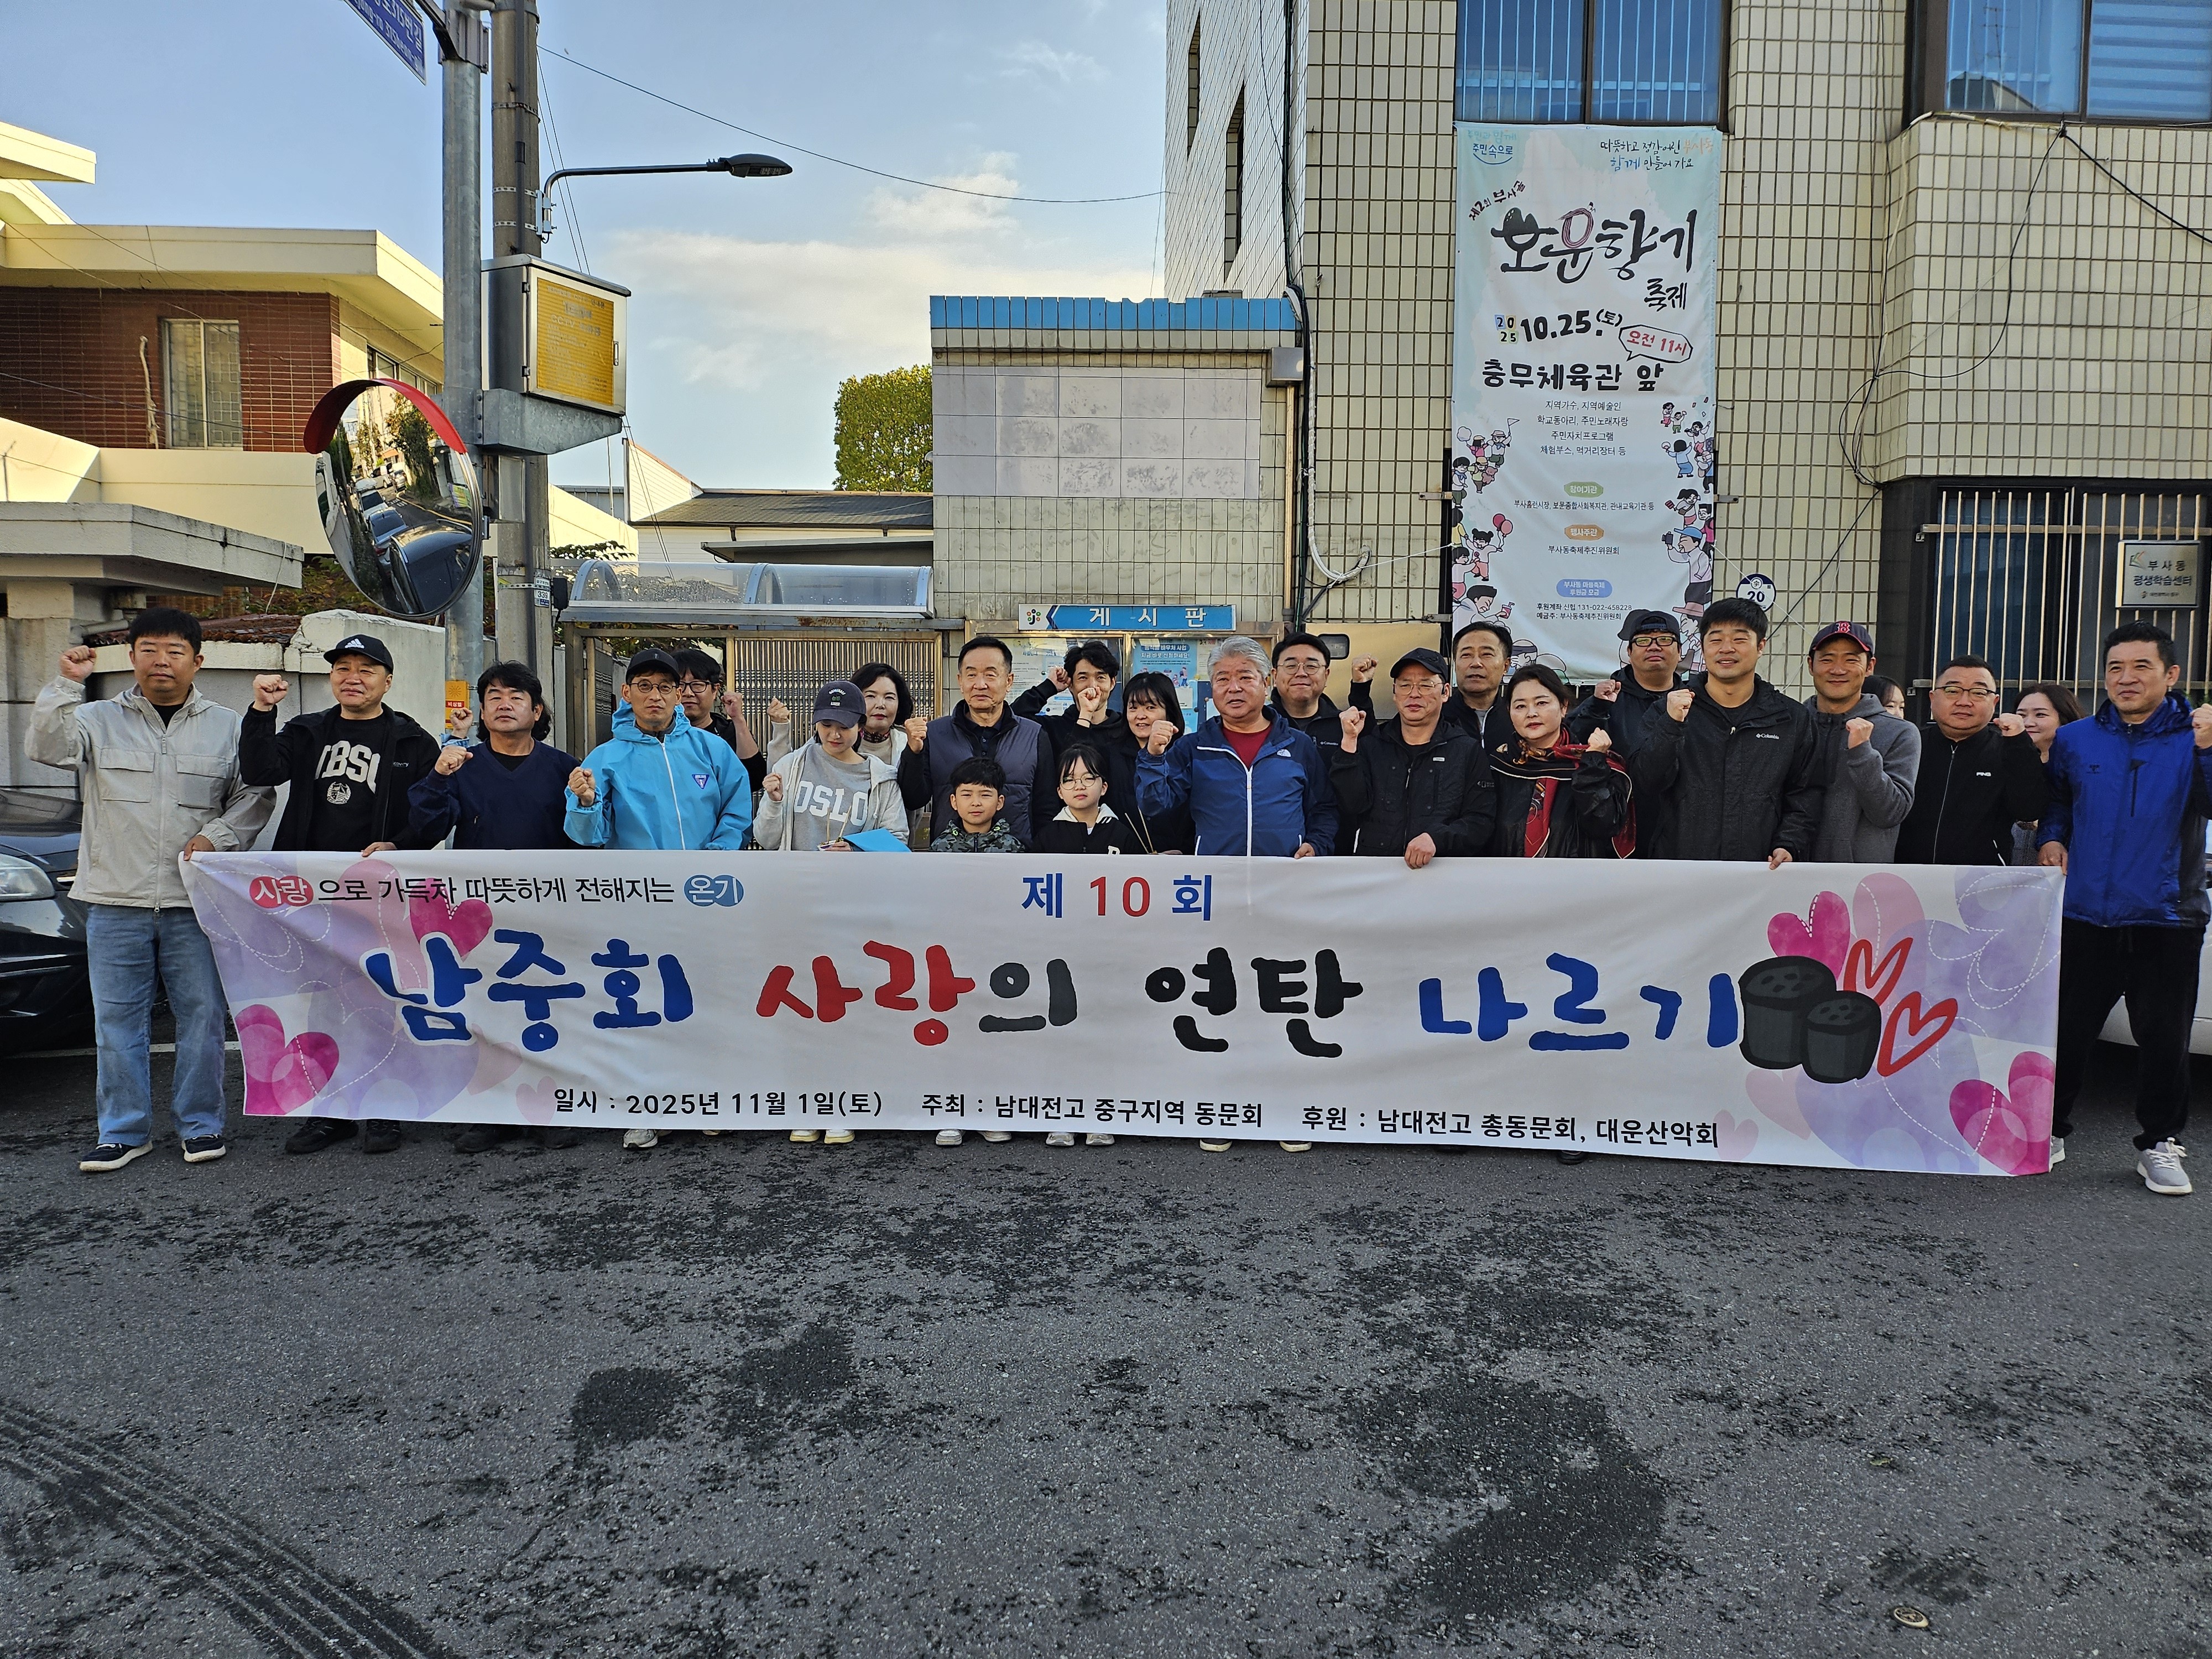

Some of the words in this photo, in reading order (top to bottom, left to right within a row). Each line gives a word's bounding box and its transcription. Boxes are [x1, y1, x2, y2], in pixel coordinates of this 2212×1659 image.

[1600, 139, 1640, 153] 따뜻하고
[1642, 139, 1680, 154] 정감어린
[1683, 138, 1714, 154] 부사동
[1610, 155, 1641, 171] 함께
[1644, 155, 1672, 170] 만들어
[1674, 156, 1694, 169] 가요
[1469, 197, 1492, 221] 제2회
[1644, 278, 1687, 312] 축제
[1496, 316, 1515, 329] 20
[1500, 331, 1517, 343] 25
[1627, 330, 1655, 348] 오전
[1660, 337, 1687, 356] 11시
[1482, 358, 1623, 392] 충무체육관
[1636, 363, 1664, 392] 앞
[1545, 400, 1579, 411] 지역가수,
[1582, 401, 1621, 411] 지역예술인
[1537, 415, 1579, 426] 학교동아리,
[1581, 416, 1628, 426] 주민노래자랑
[1551, 431, 1614, 441] 주민자치프로그램
[1540, 445, 1574, 455] 체험부스,
[1576, 446, 1615, 456] 먹거리장터
[1618, 447, 1626, 456] 등
[1570, 486, 1598, 494] 참여기관
[1514, 500, 1551, 510] 부사홈런시장,
[1553, 502, 1609, 511] 보문종합사회복지관,
[1610, 502, 1646, 510] 관내교육기관
[1648, 502, 1655, 510] 등
[1570, 528, 1598, 536] 행사주관
[1548, 545, 1619, 555] 부사동축제추진위원회
[2133, 575, 2192, 586] 평생학습센터
[538, 591, 548, 599] 339
[1747, 591, 1765, 603] 20
[794, 780, 868, 826] OSLO
[382, 877, 456, 904] 가득차
[467, 877, 567, 904] 따뜻하게
[575, 877, 675, 903] 전해지는
[688, 877, 739, 904] 온기
[363, 928, 695, 1053] 남중회
[755, 940, 1078, 1046] 사랑의
[1144, 947, 1364, 1058] 연탄
[1418, 952, 1739, 1051] 나르기
[626, 1092, 720, 1116] 2025년
[731, 1091, 786, 1115] 11월
[798, 1091, 883, 1117] 1일(토)
[995, 1095, 1086, 1120] 남대전고
[1094, 1098, 1185, 1125] 중구지역
[1194, 1102, 1262, 1128] 동문회
[1377, 1109, 1472, 1135] 남대전고
[1480, 1113, 1586, 1142] 총동문회,
[1596, 1118, 1719, 1148] 대운산악회
